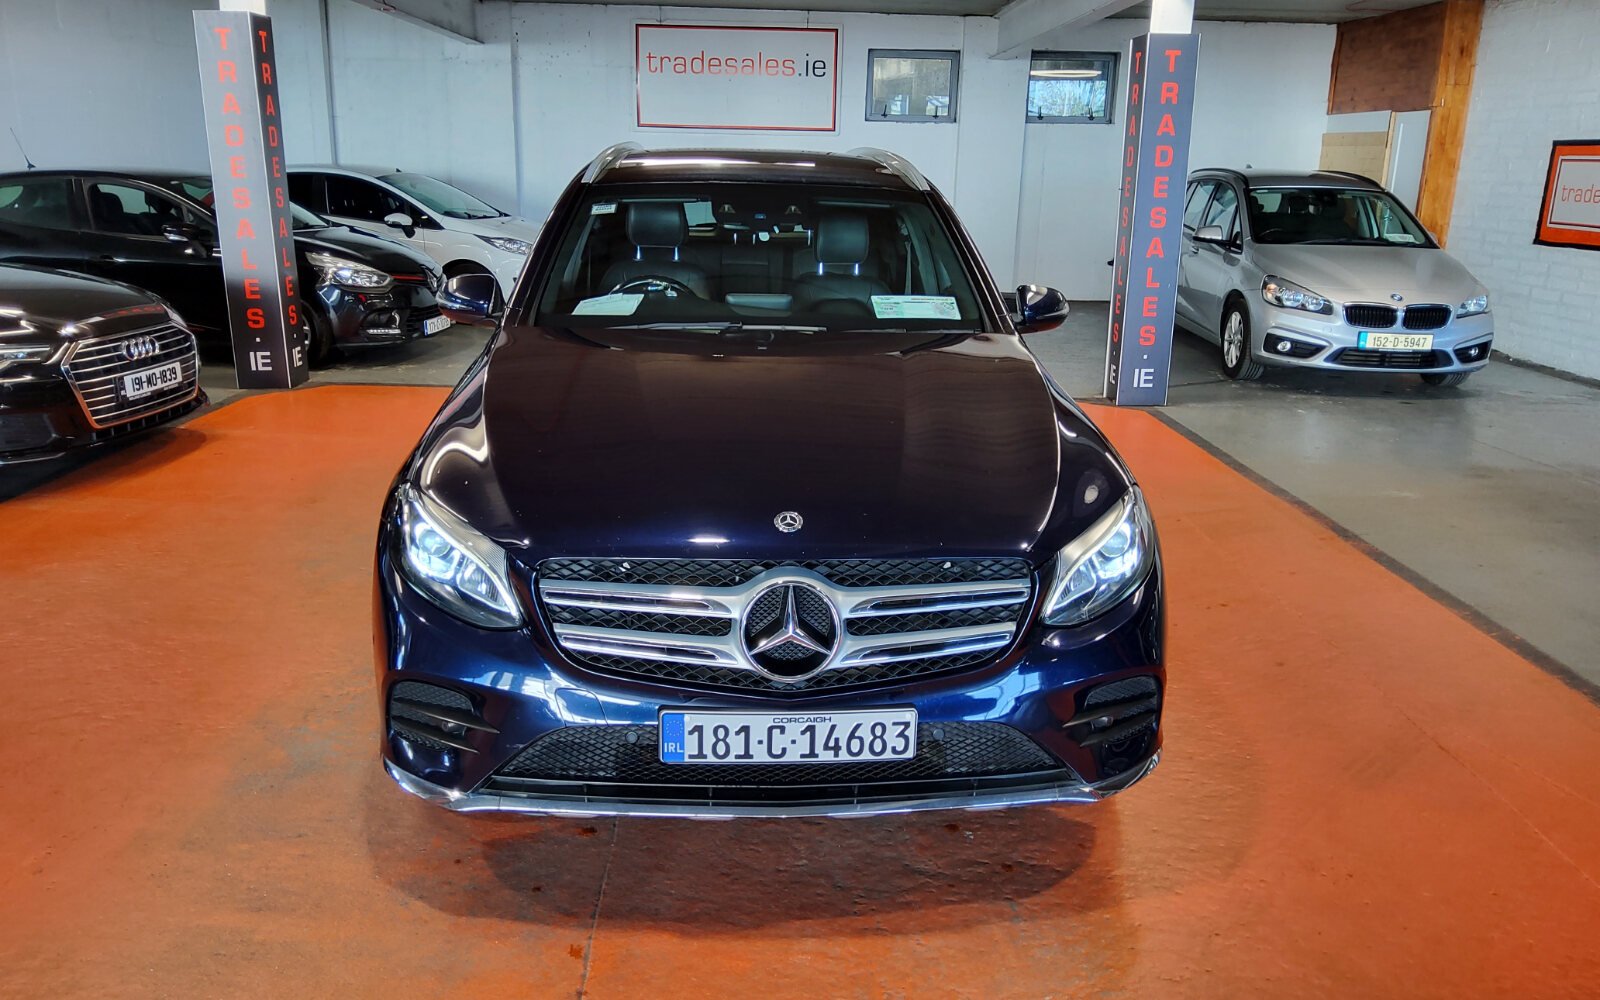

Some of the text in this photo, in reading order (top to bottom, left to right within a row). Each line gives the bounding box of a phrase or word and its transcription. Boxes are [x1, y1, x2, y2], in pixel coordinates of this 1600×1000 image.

[646, 50, 826, 77] tradesales.ie
[1372, 336, 1428, 348] 152-D-5947
[131, 366, 178, 393] 191-MO-1839
[772, 716, 832, 724] CORCAIGH
[664, 742, 684, 753] IRL
